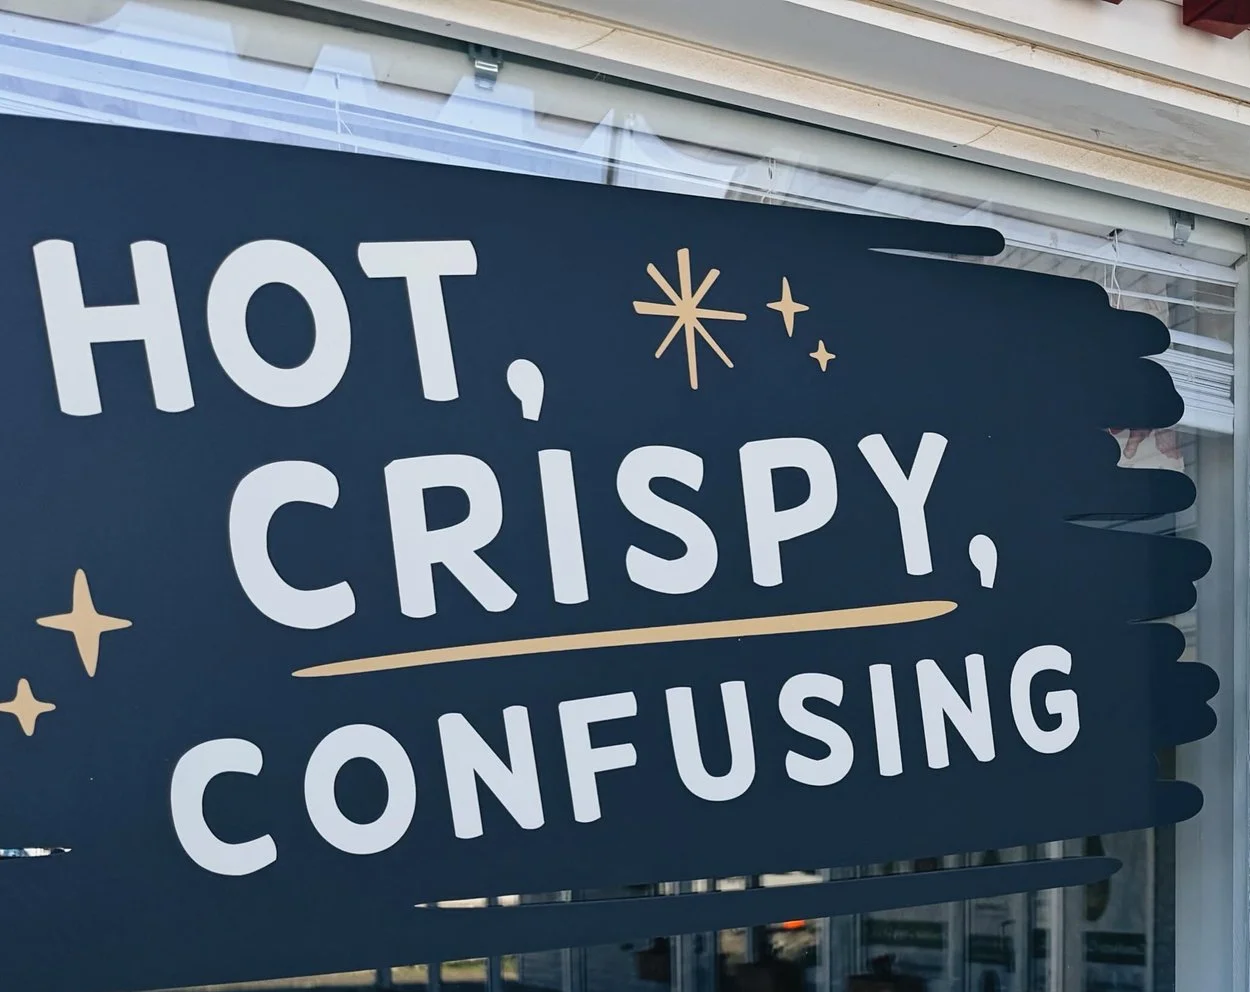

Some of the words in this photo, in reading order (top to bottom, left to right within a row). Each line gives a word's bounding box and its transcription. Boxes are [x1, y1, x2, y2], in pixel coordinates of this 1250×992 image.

[33, 240, 545, 421] HOT,
[230, 433, 998, 630] CRISPY,
[171, 645, 1080, 876] CONFUSING
